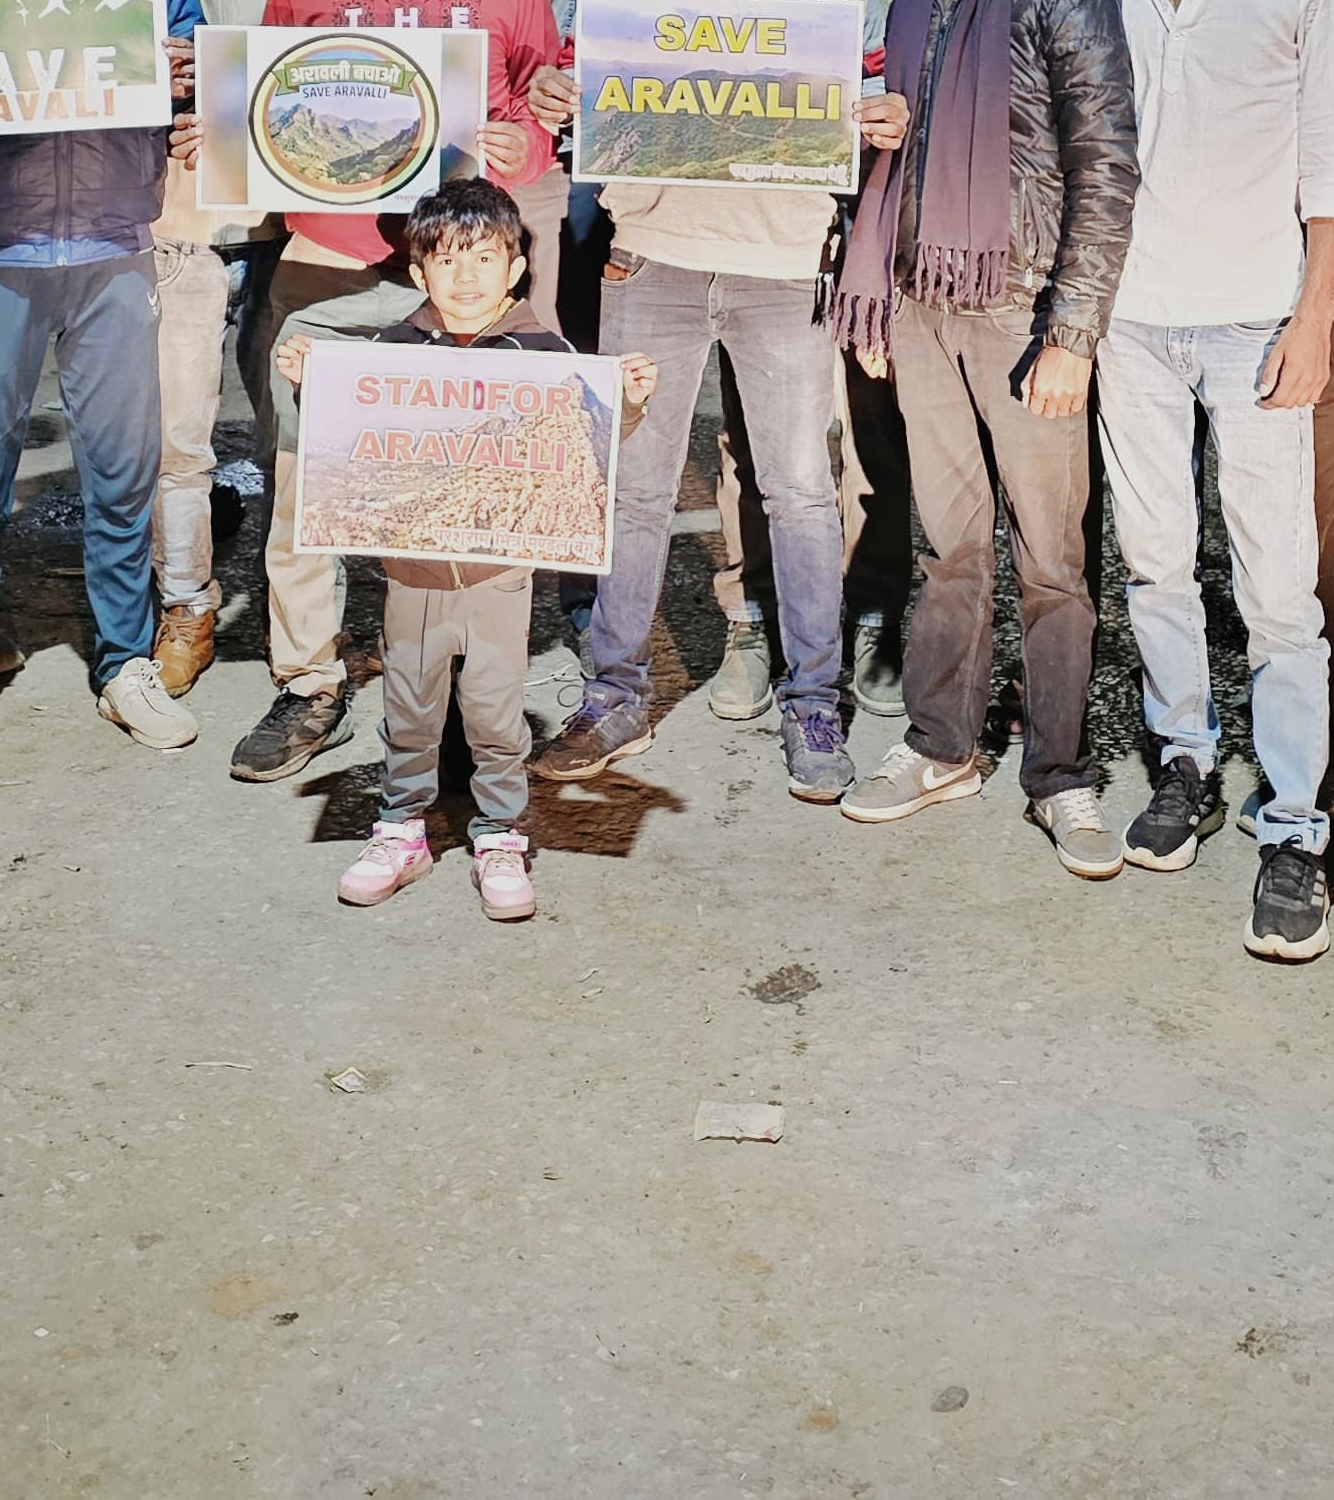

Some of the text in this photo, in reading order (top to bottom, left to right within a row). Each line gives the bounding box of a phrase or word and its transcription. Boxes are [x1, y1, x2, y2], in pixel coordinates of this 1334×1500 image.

[654, 14, 787, 55] SAVE
[289, 60, 401, 84] अरावली बचाओ
[303, 85, 388, 99] SAVE ARAVALLI
[594, 76, 842, 121] ARAVALLI
[487, 381, 573, 418] FOR
[350, 427, 568, 475] ARAVALLI
